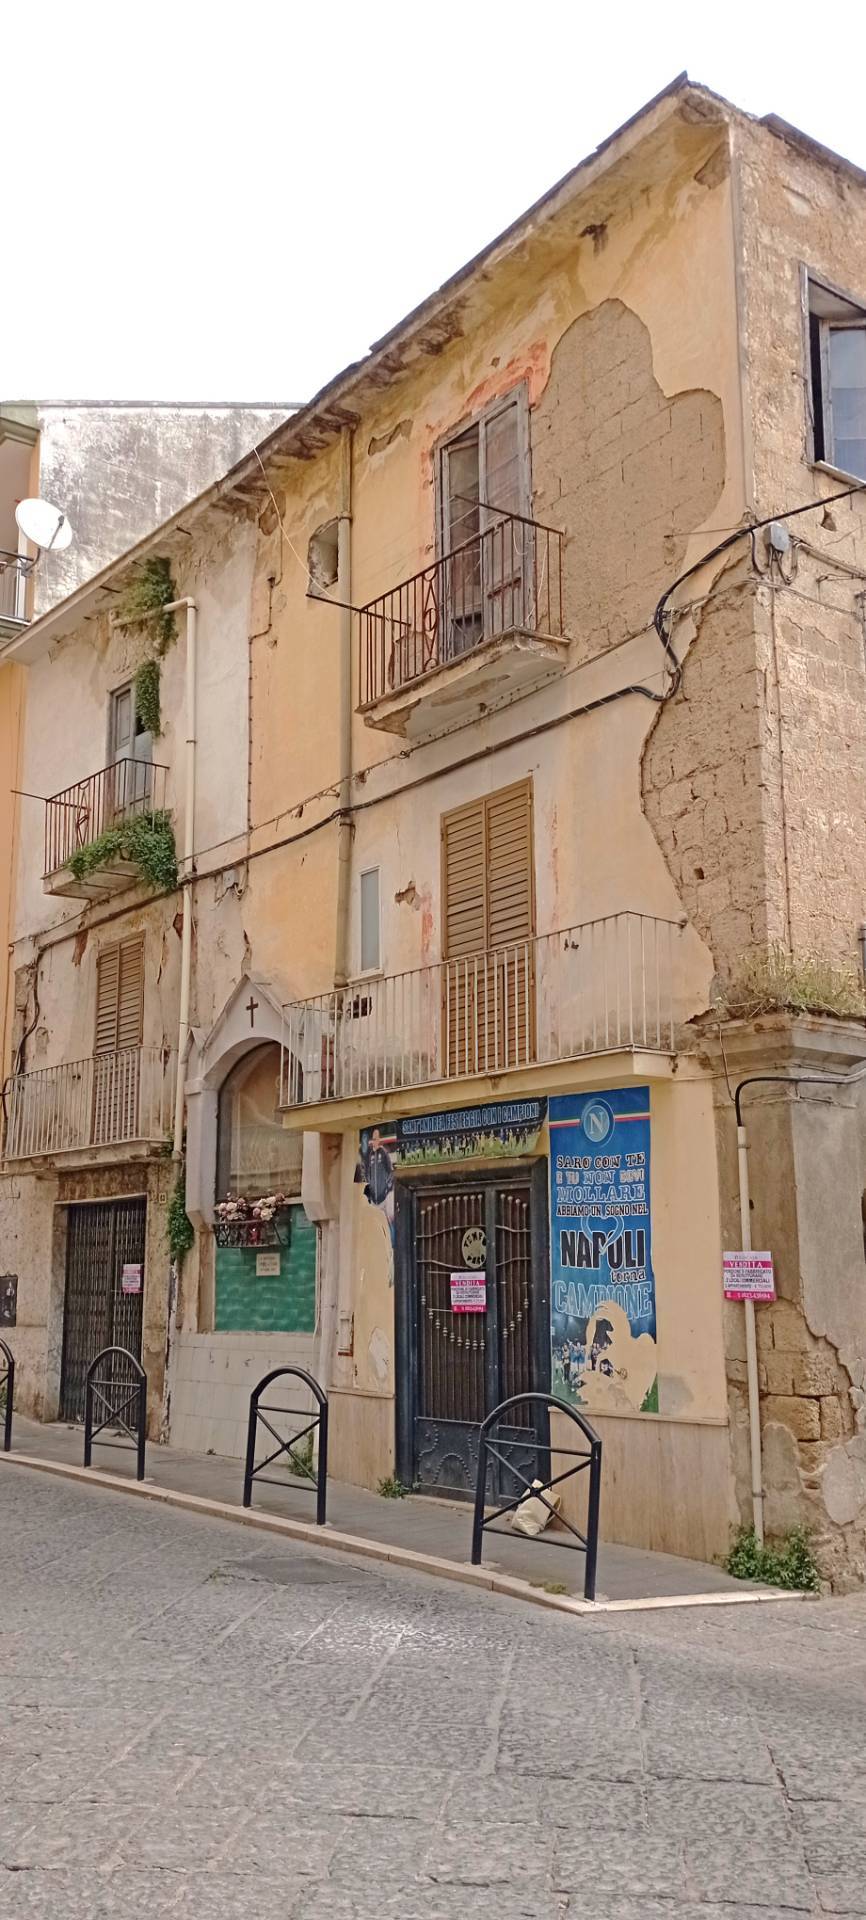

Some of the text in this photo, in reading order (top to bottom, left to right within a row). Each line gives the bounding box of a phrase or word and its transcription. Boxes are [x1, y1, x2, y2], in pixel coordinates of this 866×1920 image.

[446, 1109, 482, 1130] FESTEGGIA
[482, 1106, 497, 1126] CON
[502, 1102, 540, 1122] CAMPIONI
[589, 1111, 605, 1135] N
[594, 1154, 621, 1168] CON
[626, 1152, 645, 1167] TE
[583, 1170, 615, 1185] NON
[556, 1184, 645, 1203] MOLLARE
[557, 1202, 648, 1217] ABBIAMO UN SOGNO NEL
[560, 1228, 646, 1270] NAPOLI
[610, 1267, 646, 1284] torna
